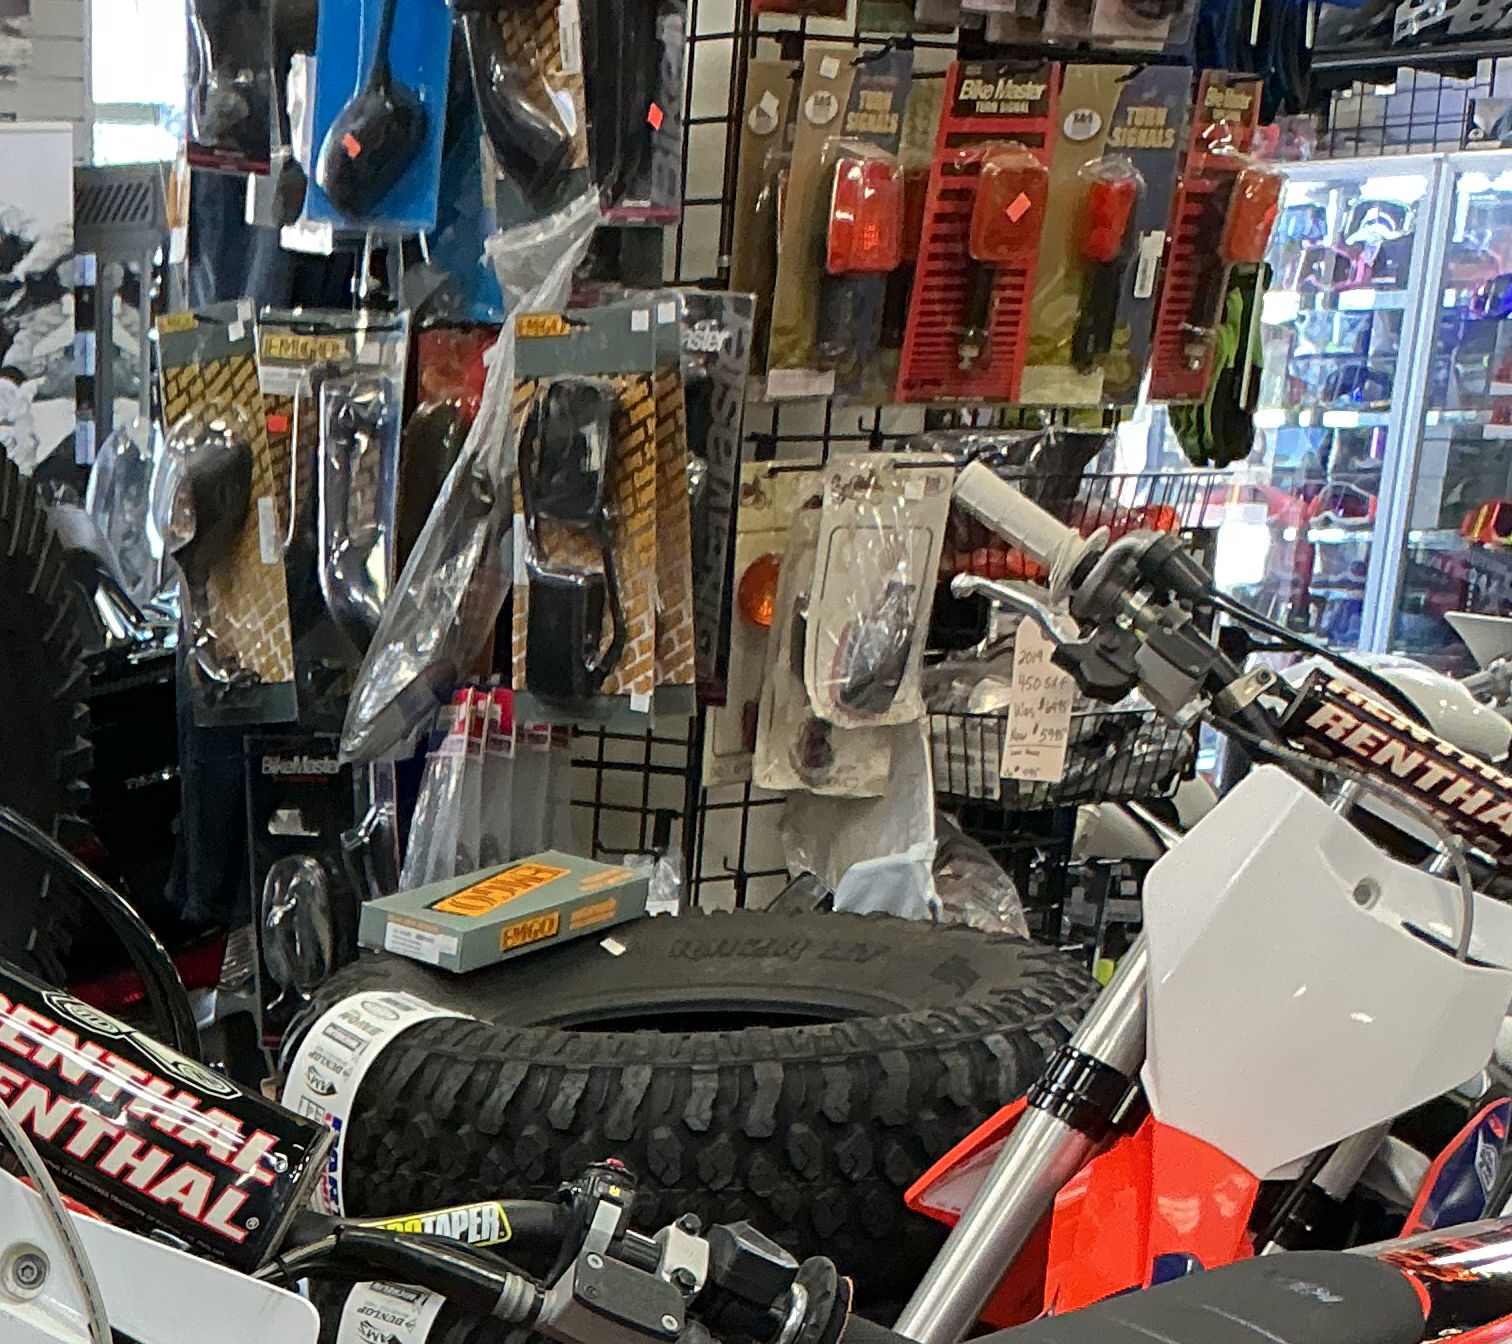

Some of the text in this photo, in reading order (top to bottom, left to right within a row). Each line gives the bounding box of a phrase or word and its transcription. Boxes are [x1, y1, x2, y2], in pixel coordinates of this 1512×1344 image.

[1108, 127, 1176, 148] SIGNALS
[1305, 700, 1512, 838] RENTHA
[357, 1305, 405, 1328] DUNLOP
